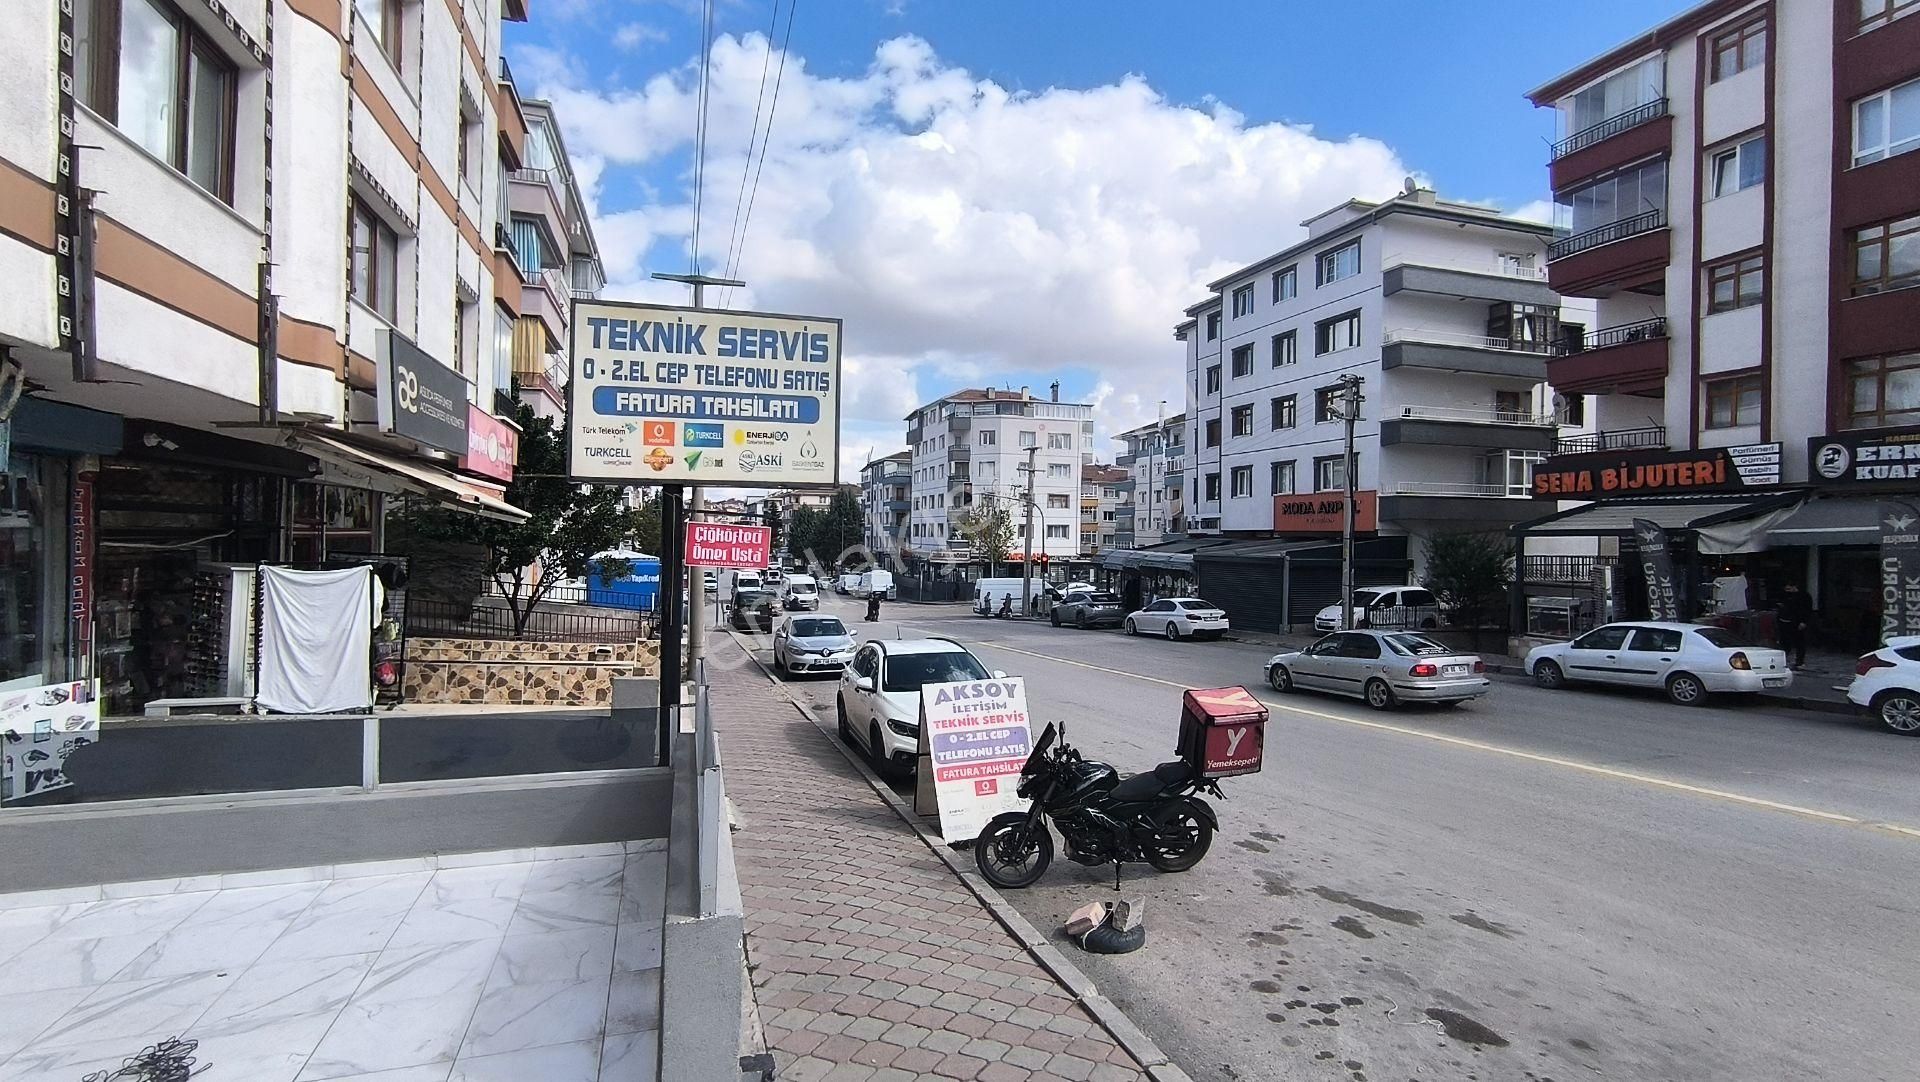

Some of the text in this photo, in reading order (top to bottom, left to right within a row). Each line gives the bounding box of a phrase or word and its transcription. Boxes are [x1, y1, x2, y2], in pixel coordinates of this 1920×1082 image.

[587, 316, 829, 363] TEKNİK SERVİS
[611, 360, 650, 382] 2.EL
[656, 363, 689, 384] CEP
[694, 365, 778, 389] TELEFONU
[783, 370, 830, 397] SATIŞ
[616, 392, 799, 419] FATURA TAHSİLATI
[582, 426, 626, 436] Türk Telekom
[584, 447, 632, 458] TURKCELL
[755, 452, 783, 466] ASKİ
[1535, 452, 1726, 494] SENA BİJUTERİ
[1282, 501, 1315, 515] MODA
[694, 526, 763, 545] Çiğköfteci
[692, 543, 728, 561] Ömer
[934, 683, 1017, 706] AKSOY
[952, 699, 1008, 714] İLETİŞİM
[933, 710, 1025, 730] TEKNİK SERVİS
[989, 729, 1010, 740] CEP
[937, 744, 1026, 761] TELEFONU SATIŞ
[1207, 756, 1258, 769] Yemeksepeti
[943, 767, 980, 780] FATURA
